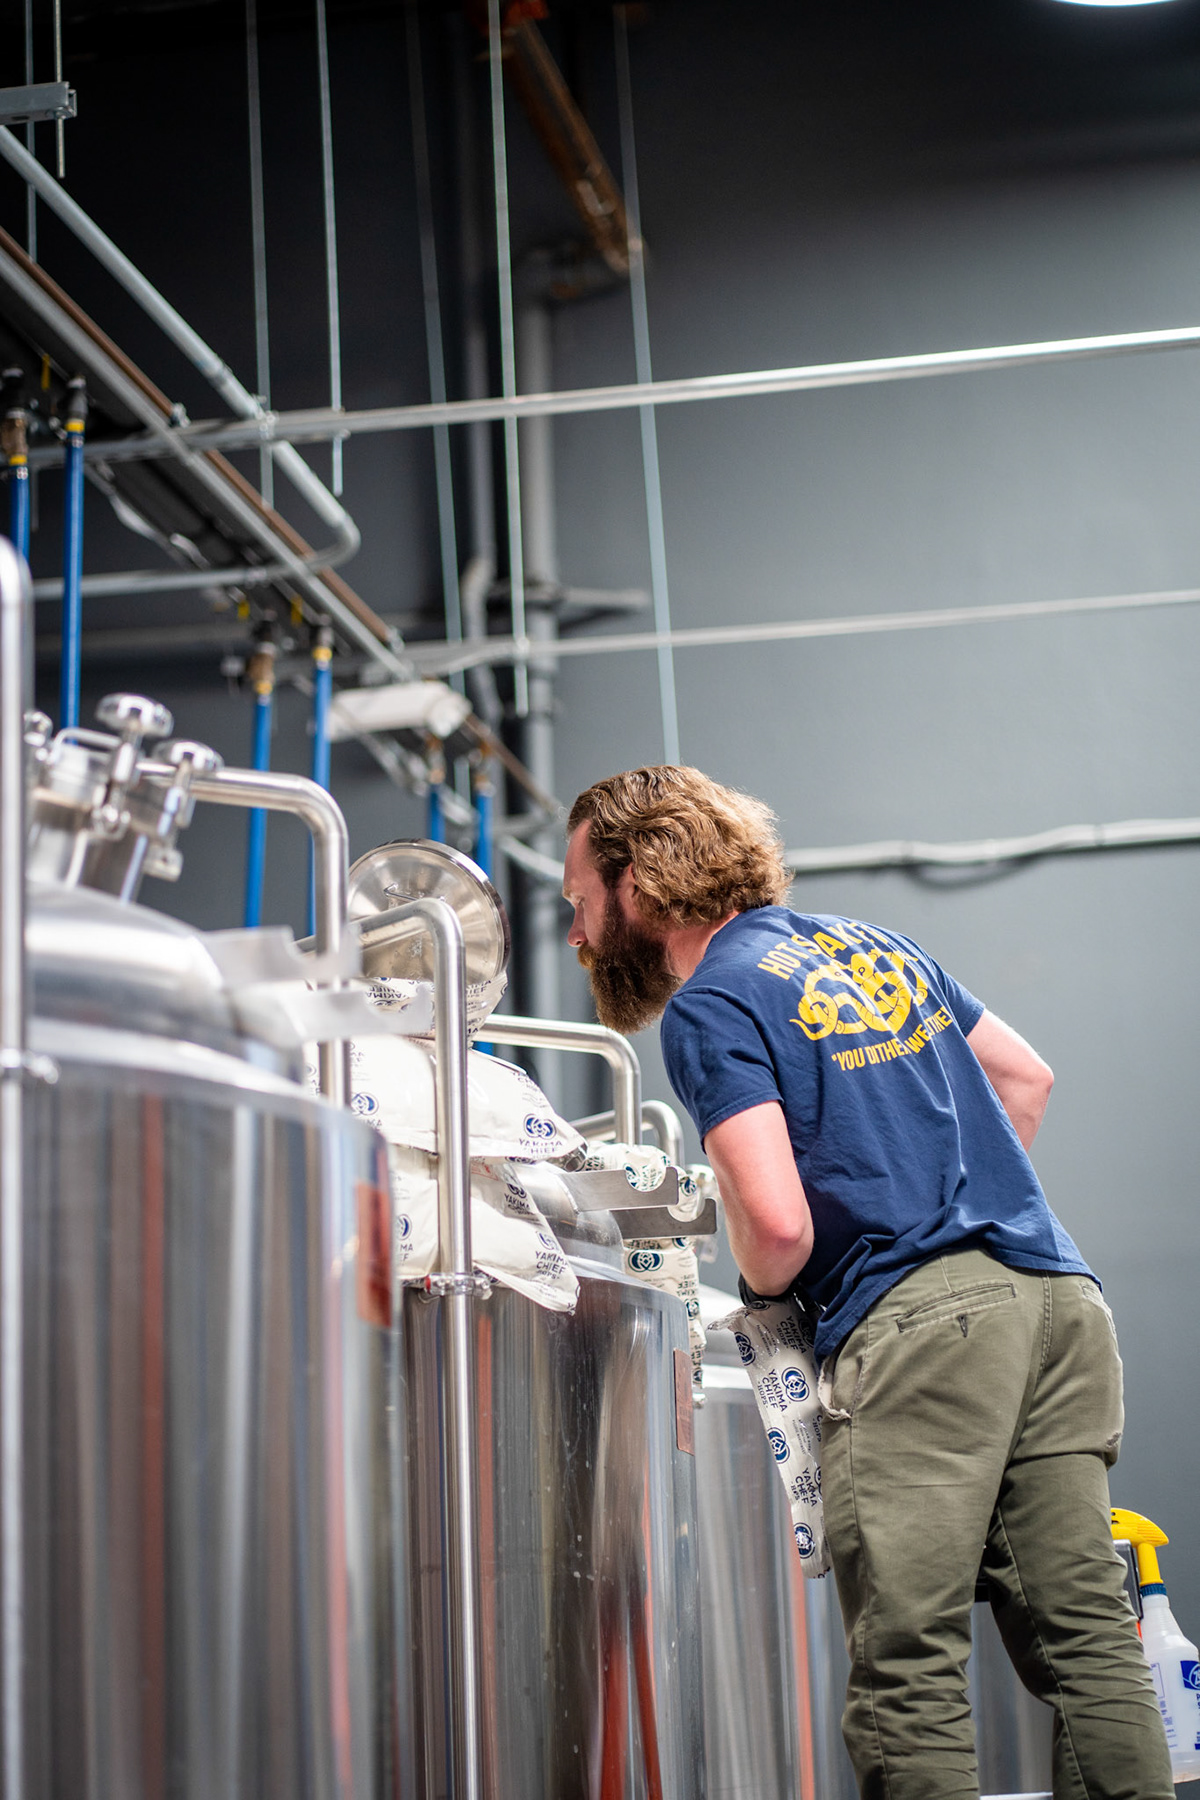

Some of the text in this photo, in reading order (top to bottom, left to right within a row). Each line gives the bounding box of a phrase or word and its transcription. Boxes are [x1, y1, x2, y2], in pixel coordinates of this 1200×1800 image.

[757, 941, 810, 980] HOT
[904, 1023, 931, 1054] WE
[536, 1261, 566, 1275] CHIEF
[780, 1321, 799, 1350] CHIEF
[786, 1315, 807, 1354] YAKIMA
[762, 1376, 778, 1409] CHIEF
[768, 1368, 788, 1412] YAKIMA
